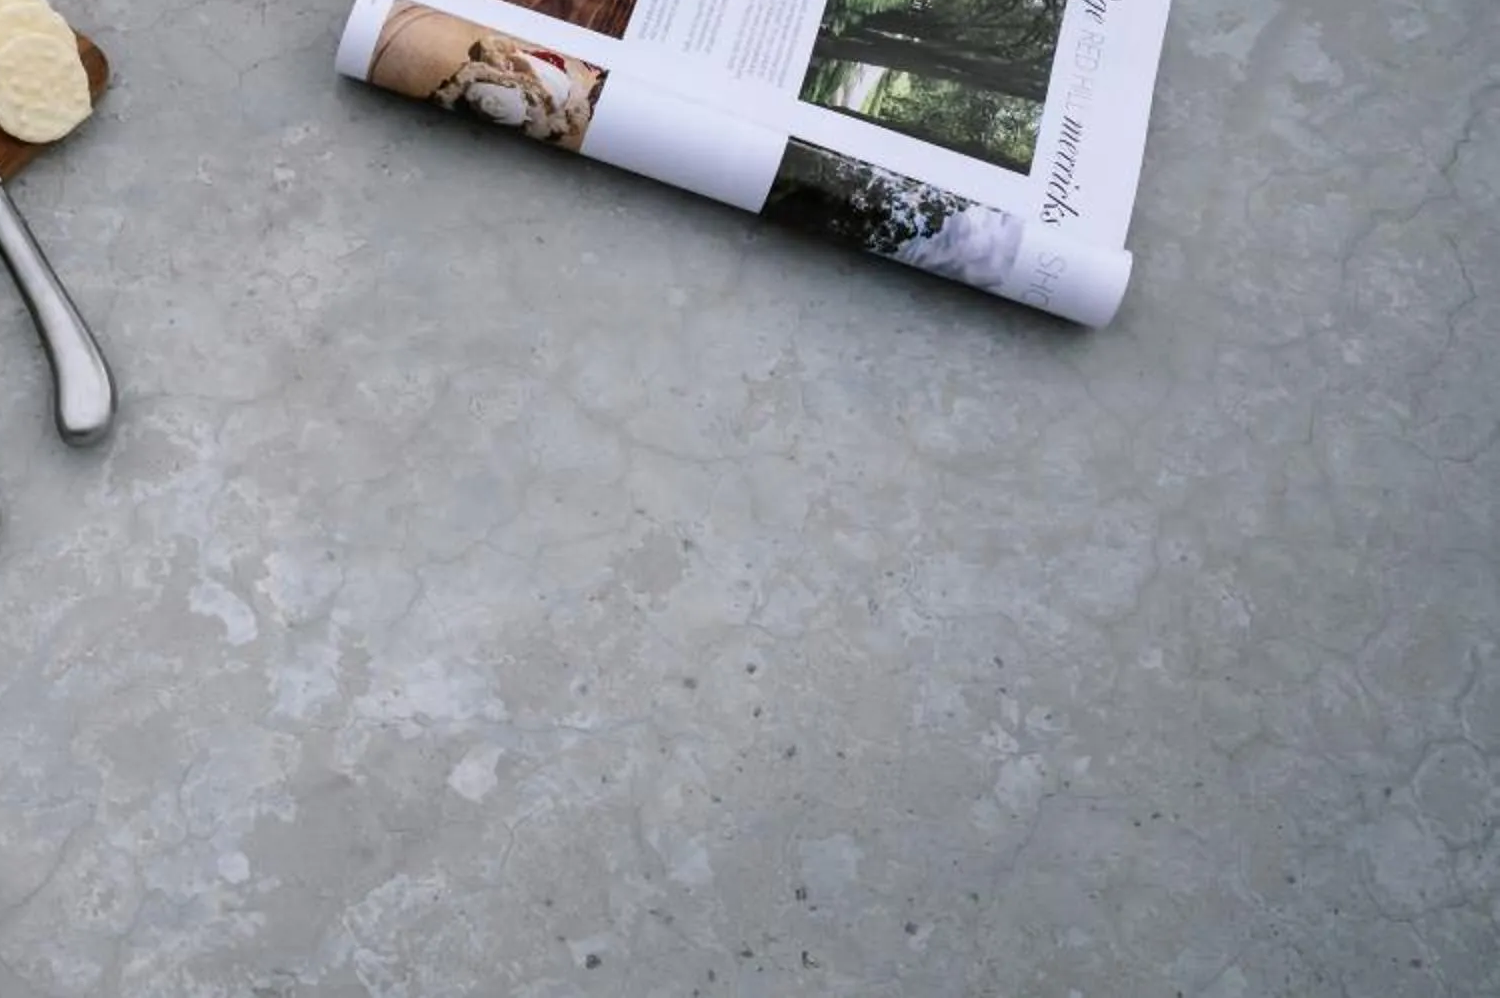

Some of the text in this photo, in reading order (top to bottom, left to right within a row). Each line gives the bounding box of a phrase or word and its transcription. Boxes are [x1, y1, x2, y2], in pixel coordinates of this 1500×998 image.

[1074, 29, 1105, 71] RED
[1063, 73, 1096, 112] HILL
[1040, 115, 1083, 226] merricks
